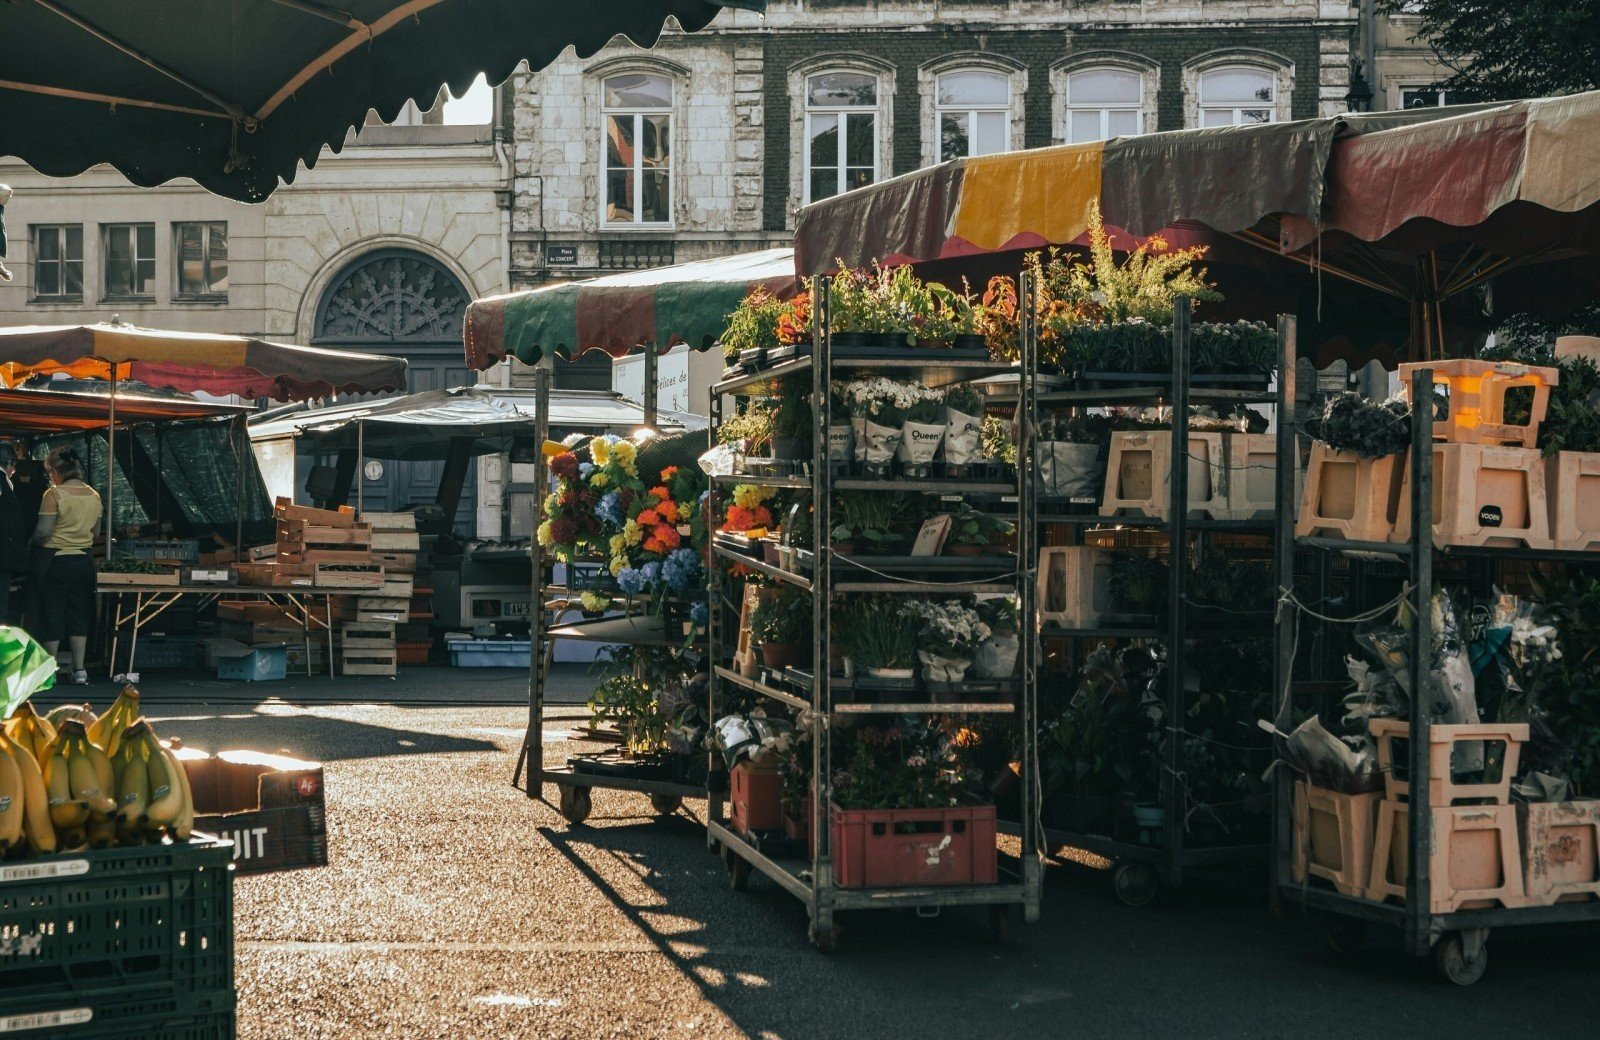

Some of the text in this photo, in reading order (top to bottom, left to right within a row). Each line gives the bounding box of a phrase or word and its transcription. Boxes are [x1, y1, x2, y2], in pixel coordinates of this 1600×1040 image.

[678, 369, 687, 383] de
[912, 430, 939, 440] Queen
[1481, 512, 1500, 521] VOORN
